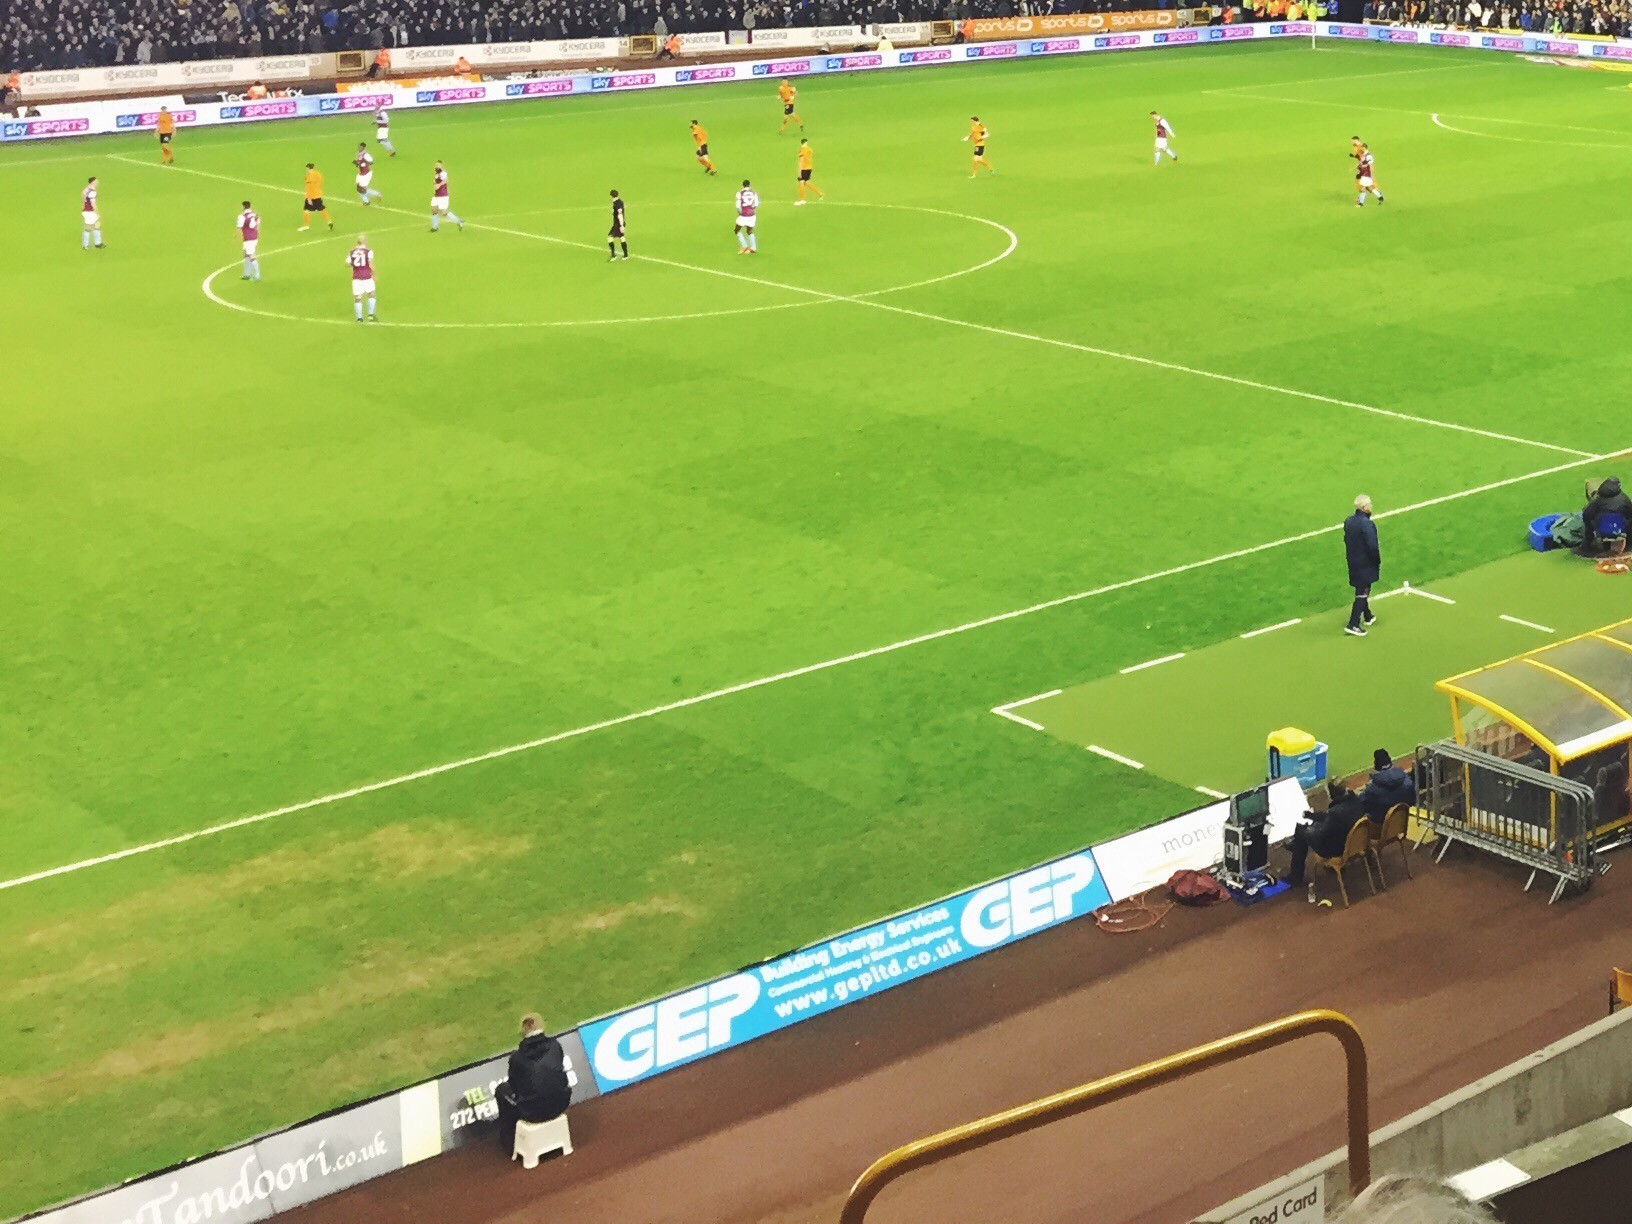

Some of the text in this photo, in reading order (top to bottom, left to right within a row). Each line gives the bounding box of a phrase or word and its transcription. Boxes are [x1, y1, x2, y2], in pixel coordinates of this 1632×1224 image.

[973, 20, 1015, 34] ports
[1040, 16, 1086, 29] sports
[1111, 14, 1155, 26] sports
[828, 56, 881, 69] sky SPORTS
[901, 50, 951, 63] sky SPORTS
[676, 68, 735, 82] sky SPORTS
[753, 61, 810, 75] sky SPORTS
[507, 81, 571, 96] sky SPORTS
[593, 75, 655, 88] sky SPORTS
[321, 95, 392, 111] sky SPORTS
[417, 88, 485, 103] sky SPORTS
[222, 103, 295, 118] sky SPORTS
[5, 120, 87, 137] sky SPORTS
[117, 116, 139, 127] sky
[353, 253, 367, 267] 21
[960, 849, 1095, 947] GEP
[759, 907, 950, 983] Building Energy Services
[774, 938, 962, 1018] www.gepltd.co.uk
[594, 974, 760, 1081] GEP
[450, 1107, 476, 1129] 272
[1282, 1186, 1319, 1219] Card
